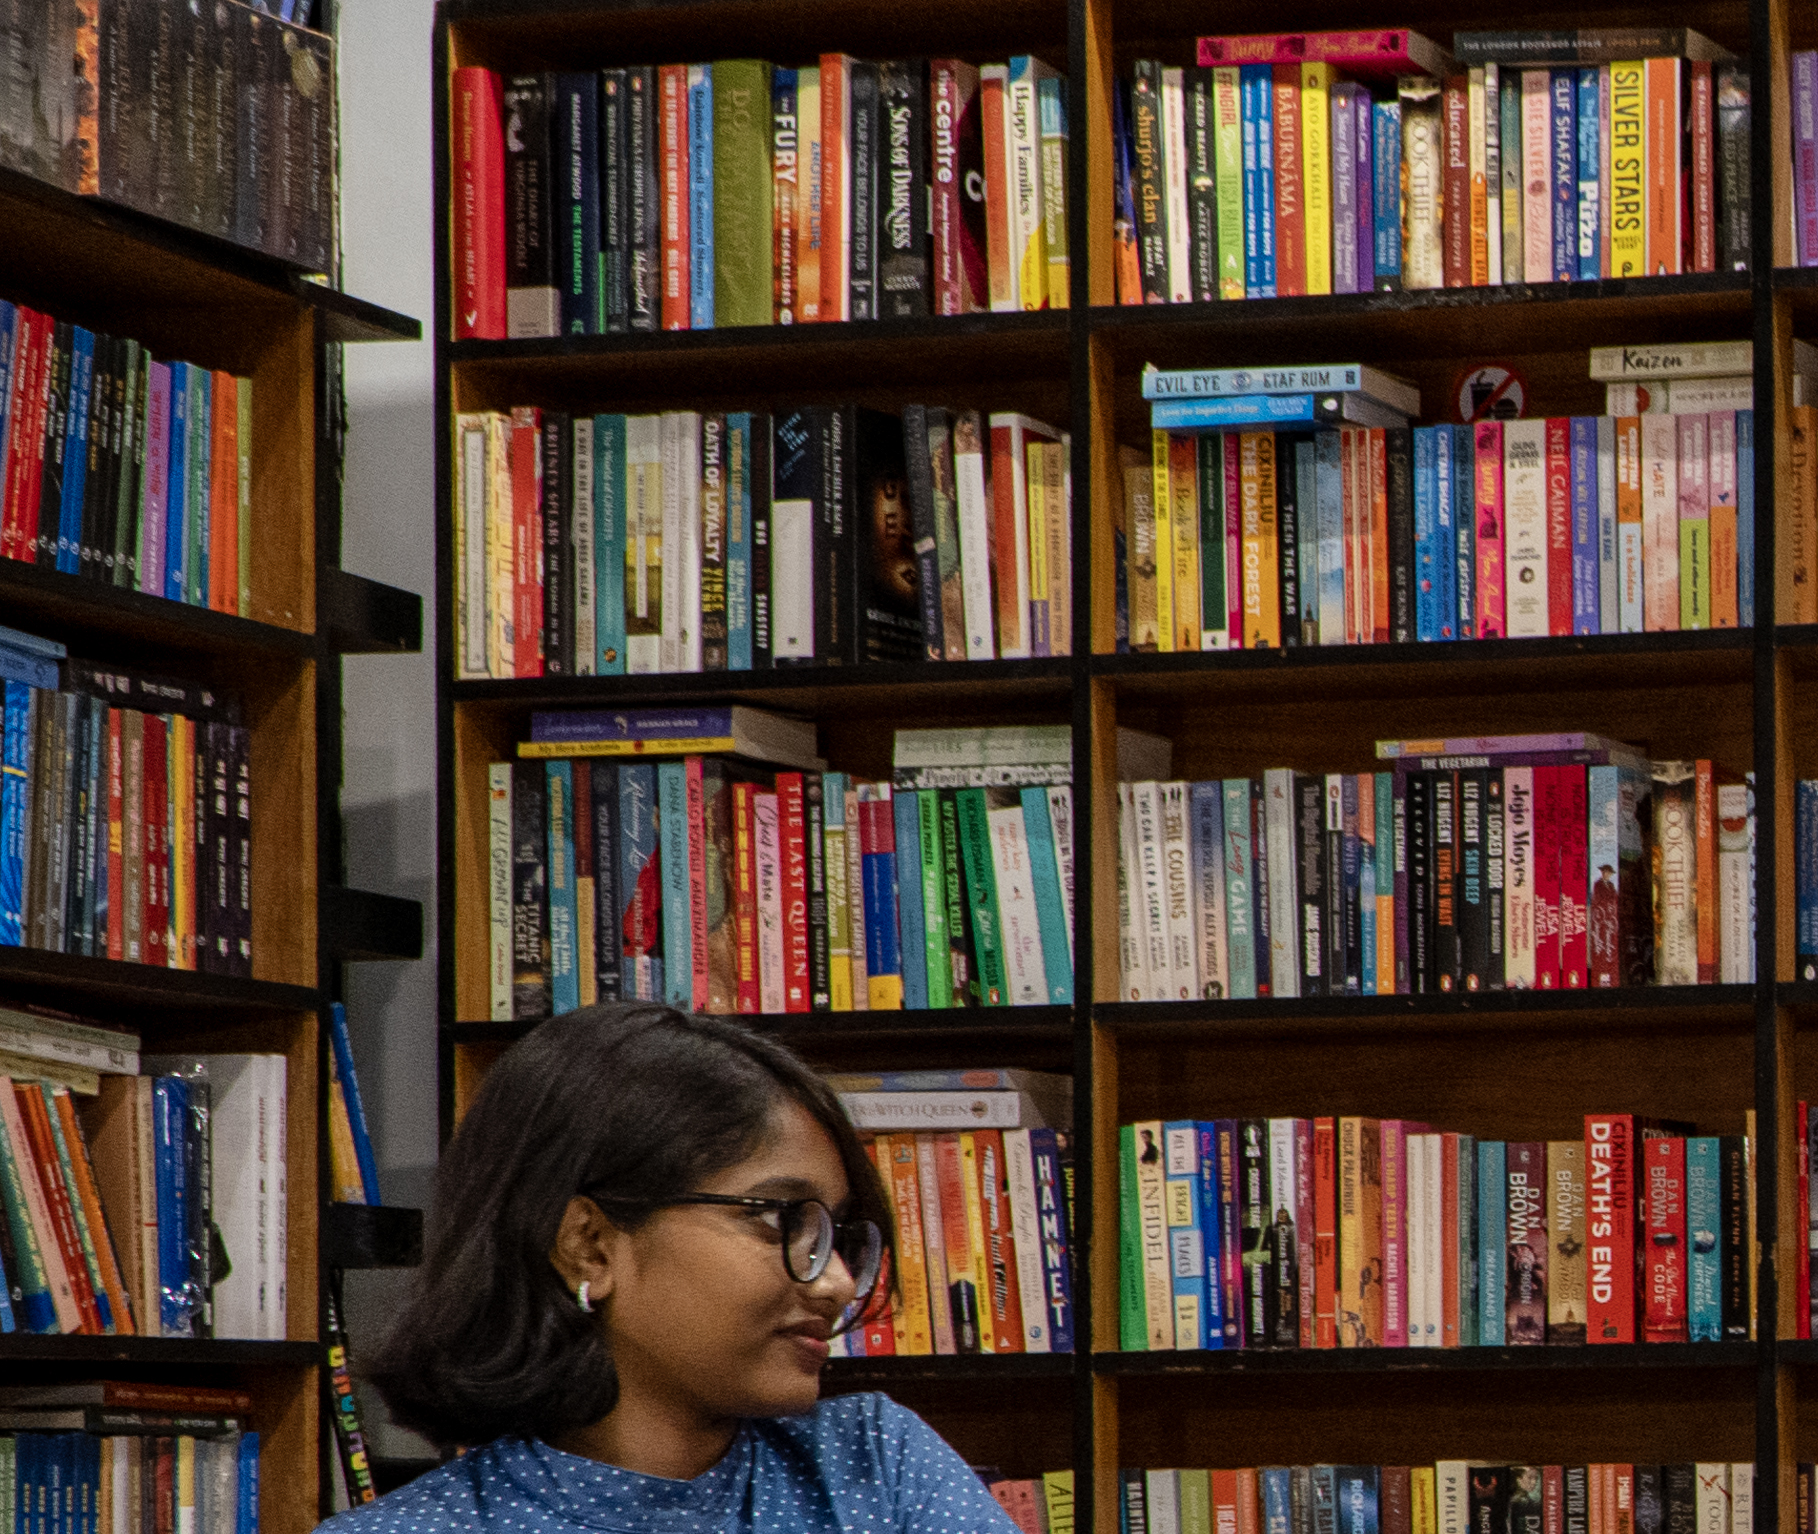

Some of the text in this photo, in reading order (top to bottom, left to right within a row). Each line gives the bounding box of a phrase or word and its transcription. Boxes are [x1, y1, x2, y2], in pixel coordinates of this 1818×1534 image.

[775, 114, 796, 185] FURY
[884, 106, 914, 249] SONS OF DARKNESS
[936, 70, 956, 184] the centre
[1012, 86, 1035, 216] Happy Families
[1136, 105, 1161, 224] shurjo's clan
[1276, 86, 1298, 218] BÁBURNÁMA
[1448, 90, 1467, 168] educated
[1555, 78, 1572, 185] ELIF SHAFAK
[1614, 71, 1640, 231] SILVER STARS
[571, 94, 583, 295] MARGARET ATWOOD THE TESTAMENTS
[1578, 181, 1599, 258] Puzo
[1155, 371, 1330, 393] EVIL EYE ETAF RUM
[1623, 347, 1683, 373] Kaizen
[704, 420, 721, 562] OATH OF LOYALTY
[1550, 428, 1568, 550] NEIL GAIMAN
[788, 783, 807, 978] THE LAST QUEEN
[1166, 814, 1188, 921] THE COUSINS
[1463, 782, 1479, 905] LIZ NUGENT SKIN DEEP
[1508, 784, 1531, 888] Jojo Moyes
[1509, 1172, 1528, 1244] BROWN
[1527, 1187, 1541, 1229] DAN
[1589, 1122, 1613, 1304] DEATH'S END
